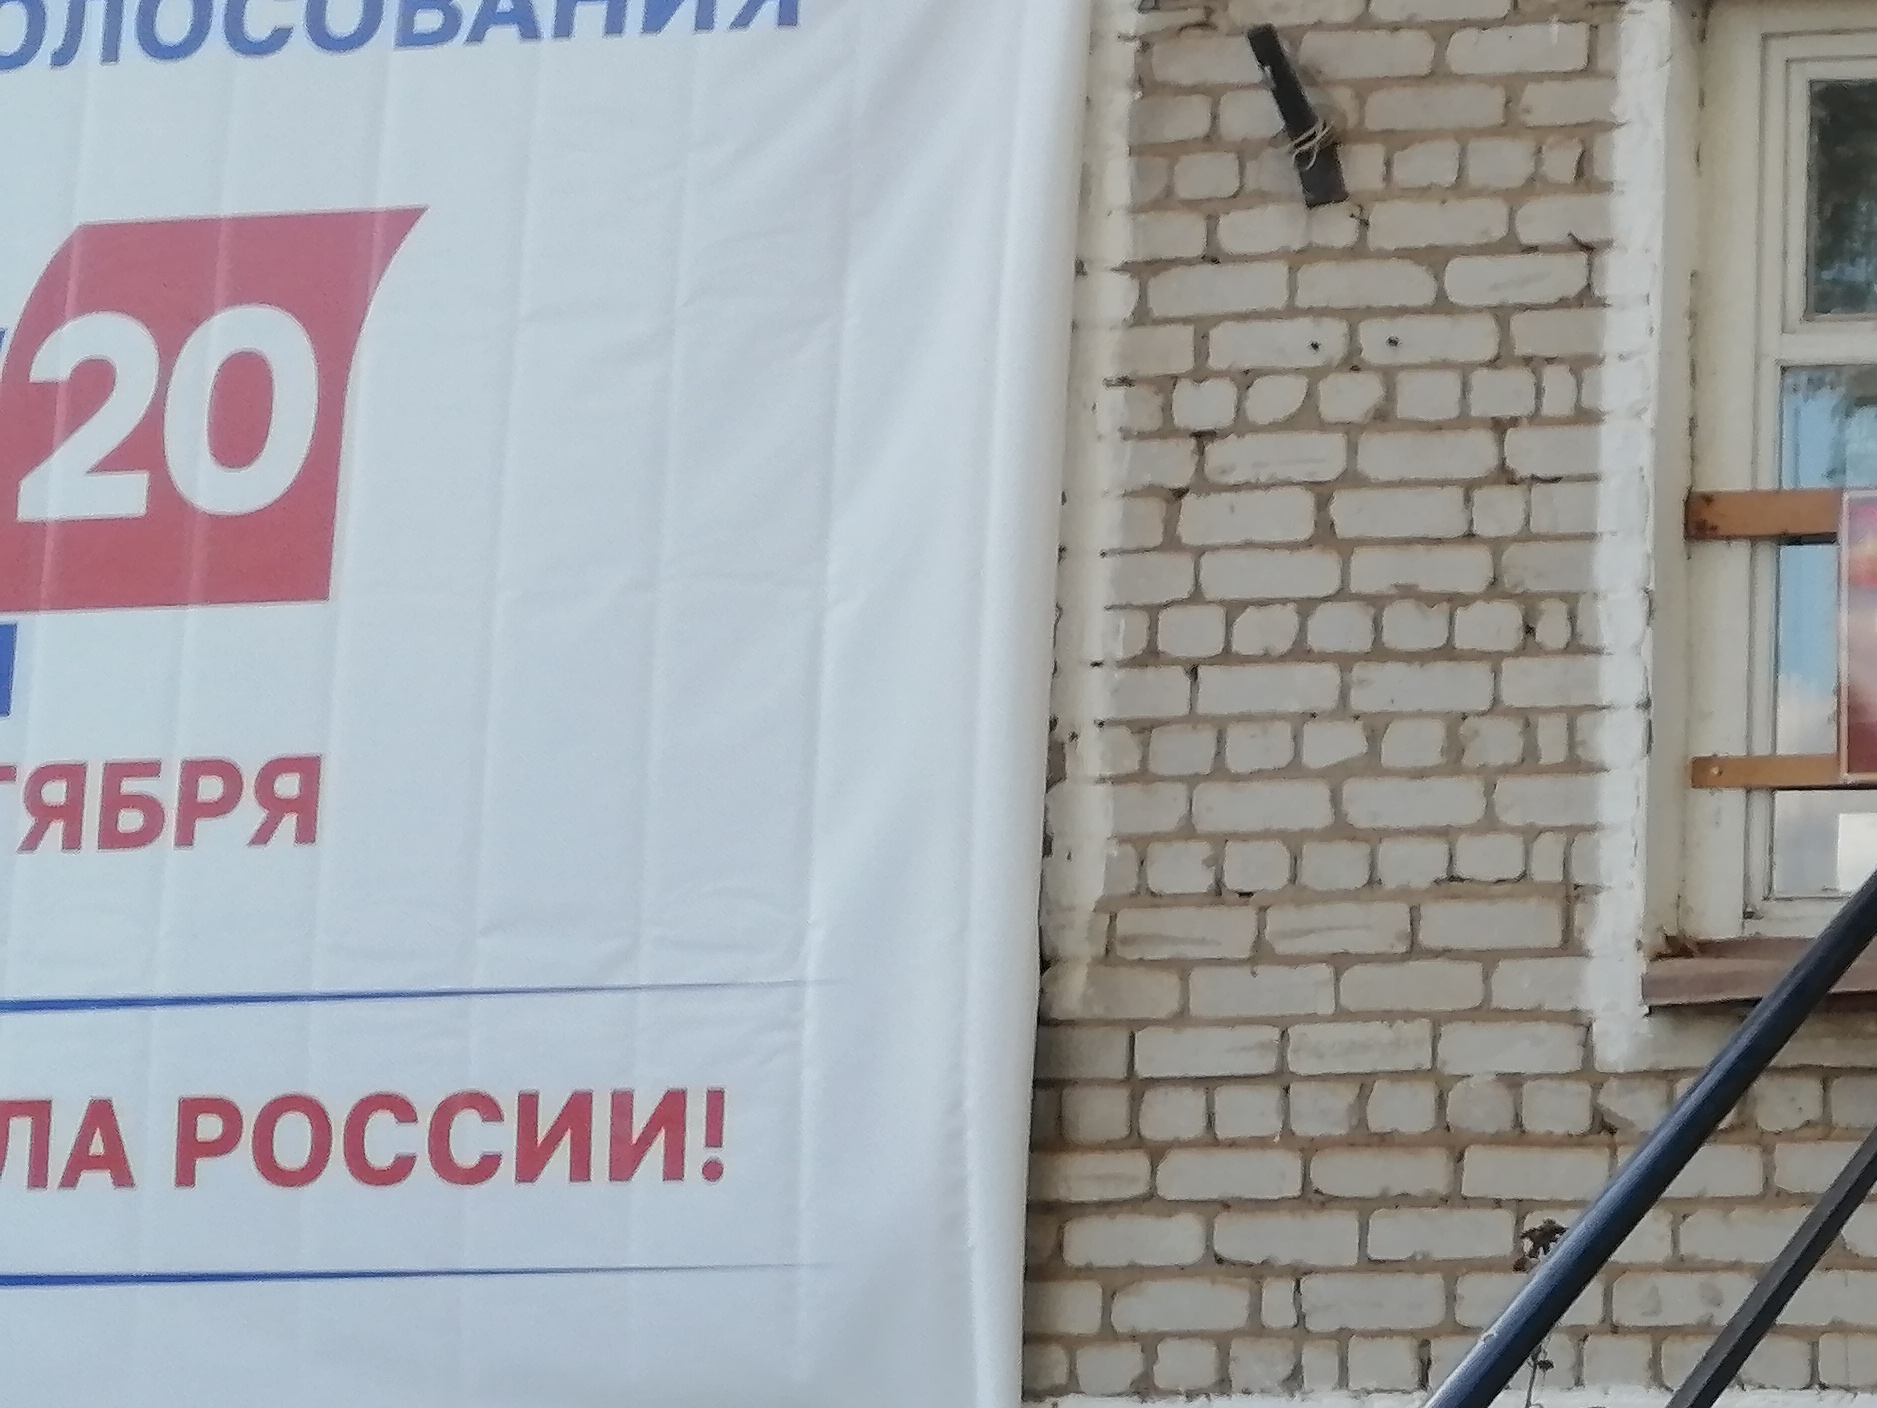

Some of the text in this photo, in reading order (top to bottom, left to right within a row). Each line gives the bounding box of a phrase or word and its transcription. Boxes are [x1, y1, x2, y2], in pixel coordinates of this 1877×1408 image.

[15, 302, 322, 523] 20
[0, 754, 322, 852] ЯБРЯ
[174, 1087, 728, 1189] РОССИИ!
